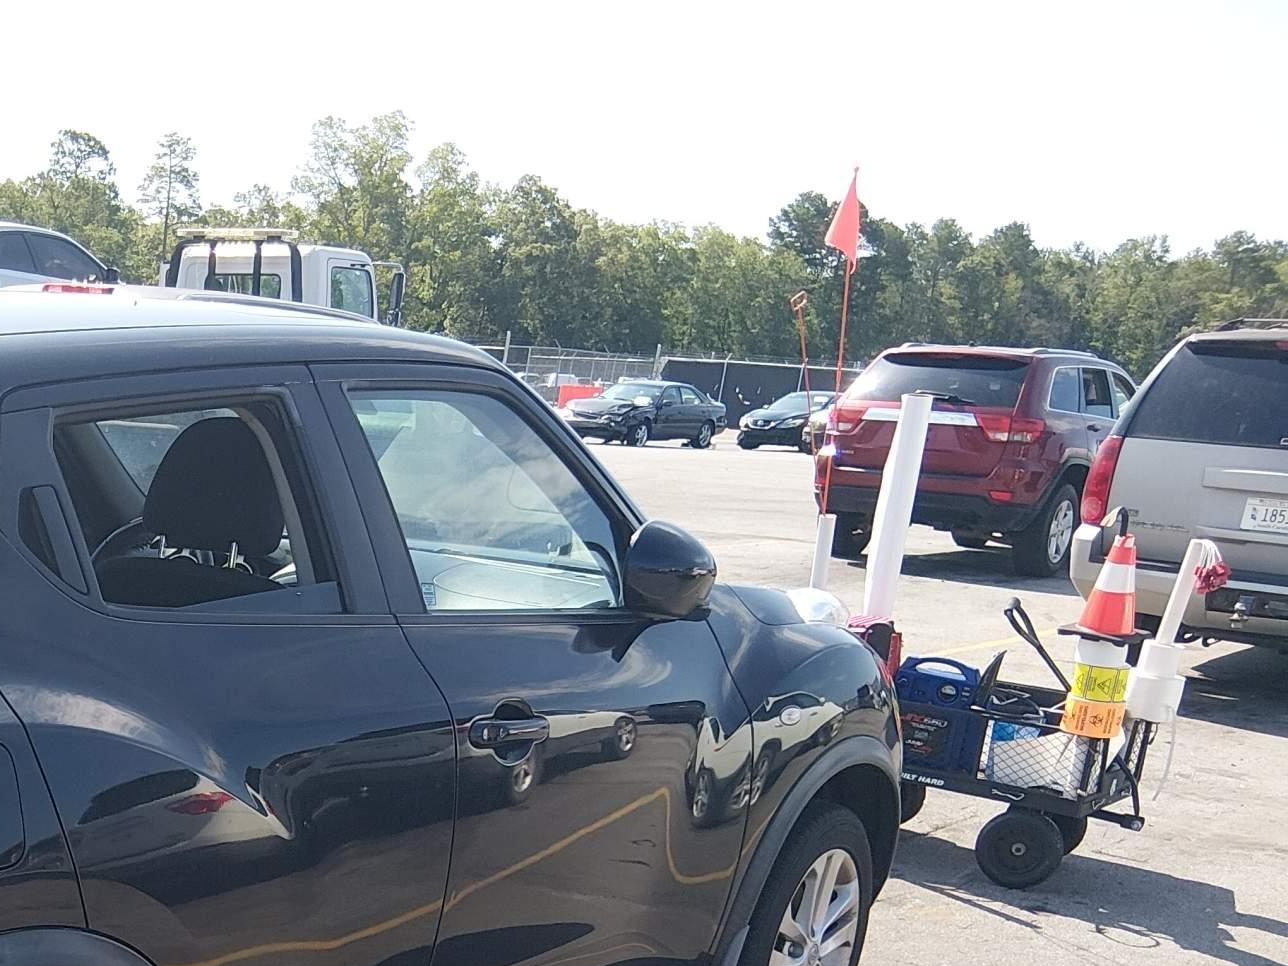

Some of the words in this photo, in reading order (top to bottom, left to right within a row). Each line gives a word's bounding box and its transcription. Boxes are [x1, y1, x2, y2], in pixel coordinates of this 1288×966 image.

[1261, 508, 1288, 525] 185
[901, 772, 918, 781] ILT
[917, 775, 945, 786] HARD
